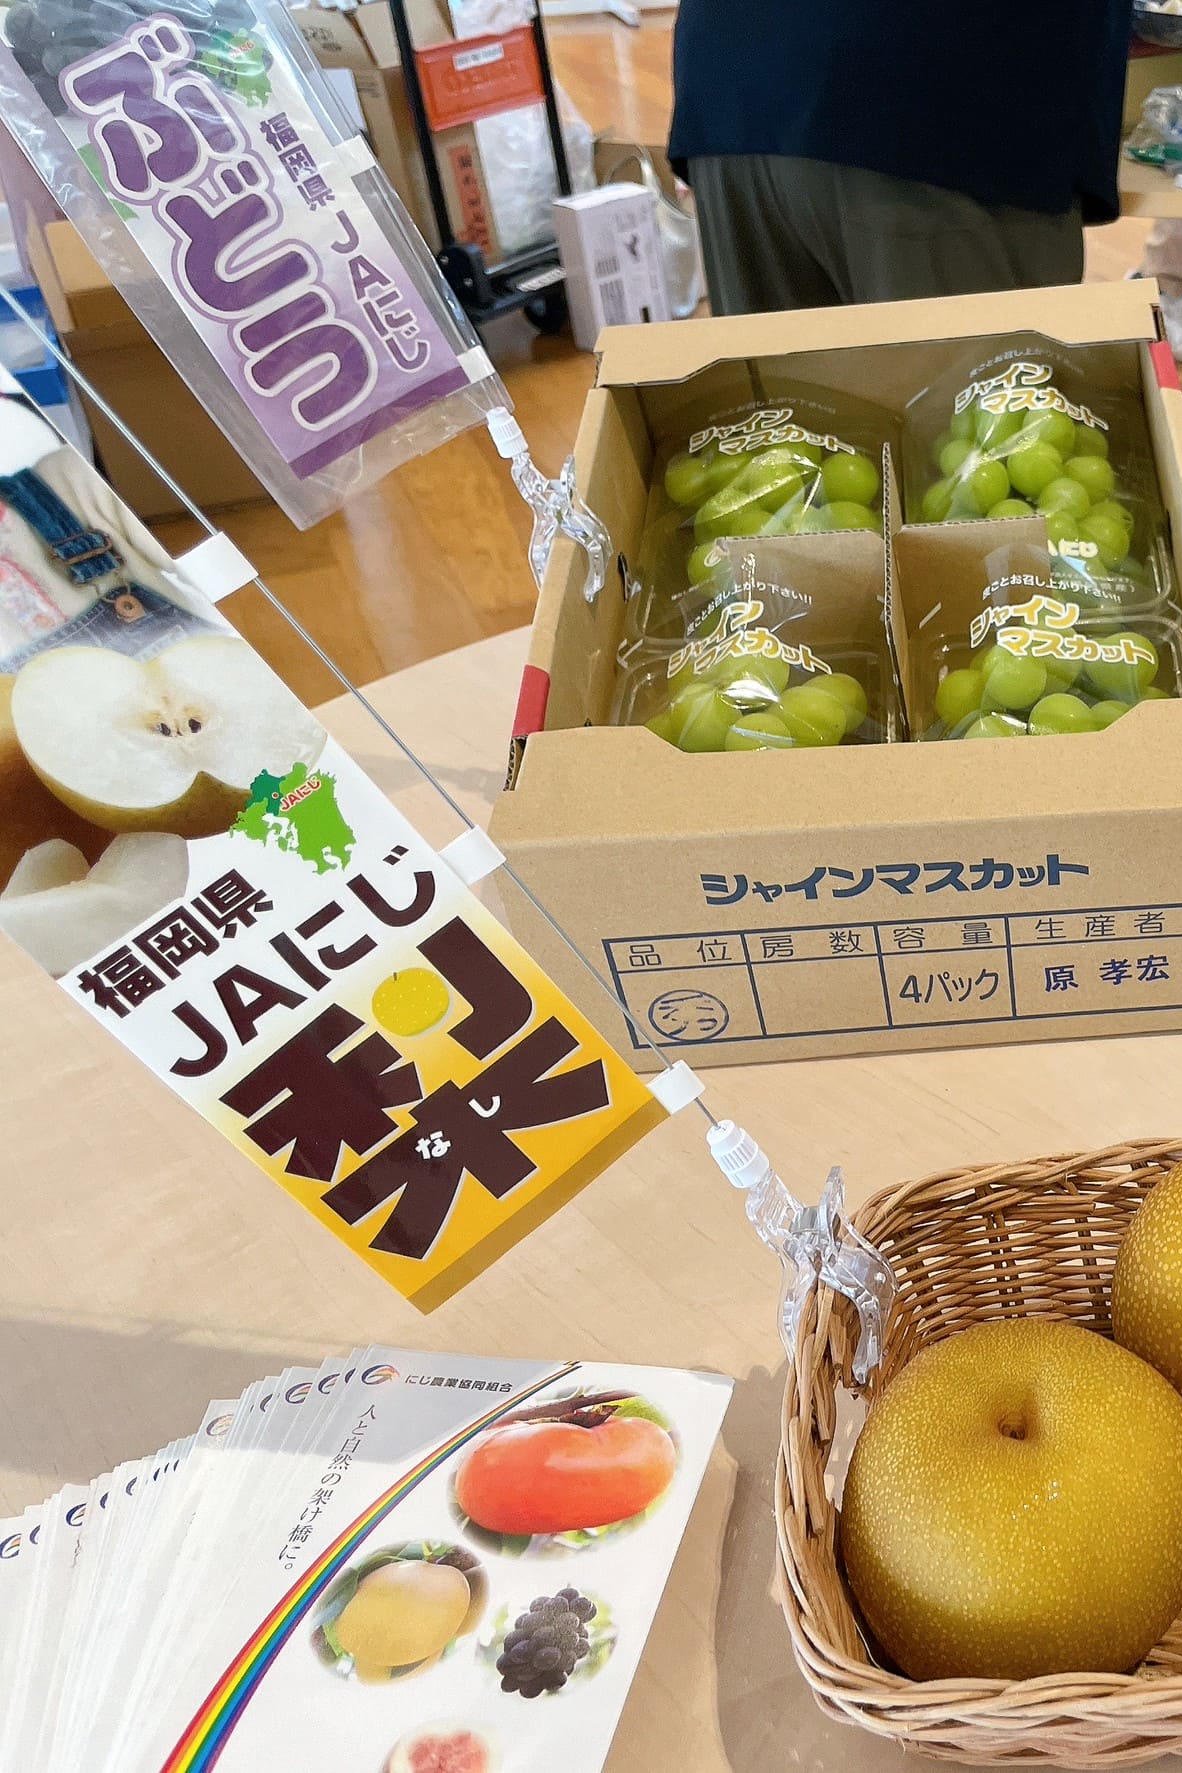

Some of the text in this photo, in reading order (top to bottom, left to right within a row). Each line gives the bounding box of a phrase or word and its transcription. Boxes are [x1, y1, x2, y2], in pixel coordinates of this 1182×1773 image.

[68, 20, 378, 431] ぶどう
[260, 112, 335, 211] 福岡県
[331, 209, 430, 371] JAにじ
[954, 362, 1052, 415] シャイン
[980, 387, 1109, 431] マスカット
[689, 408, 793, 453] シャイン
[718, 425, 856, 455] マスカット
[667, 600, 764, 679] シャイン
[970, 594, 1080, 648] シャイン
[997, 627, 1155, 665] マスカット
[693, 627, 833, 674] マスカット
[281, 777, 321, 810] JAにじ
[700, 854, 1089, 906] シャインマスカット
[78, 868, 274, 1018] 福岡県
[169, 845, 436, 1077] JAにじ
[628, 911, 1167, 967] 品位 房数 容量 生産者
[899, 968, 1001, 1004] 4パック
[1098, 954, 1170, 986] 孝宏
[219, 916, 611, 1261] 梨
[414, 1096, 501, 1160] なし
[405, 1374, 514, 1393] にじ農業協同組合
[278, 1404, 376, 1570] 人と自然の架け橋に。
